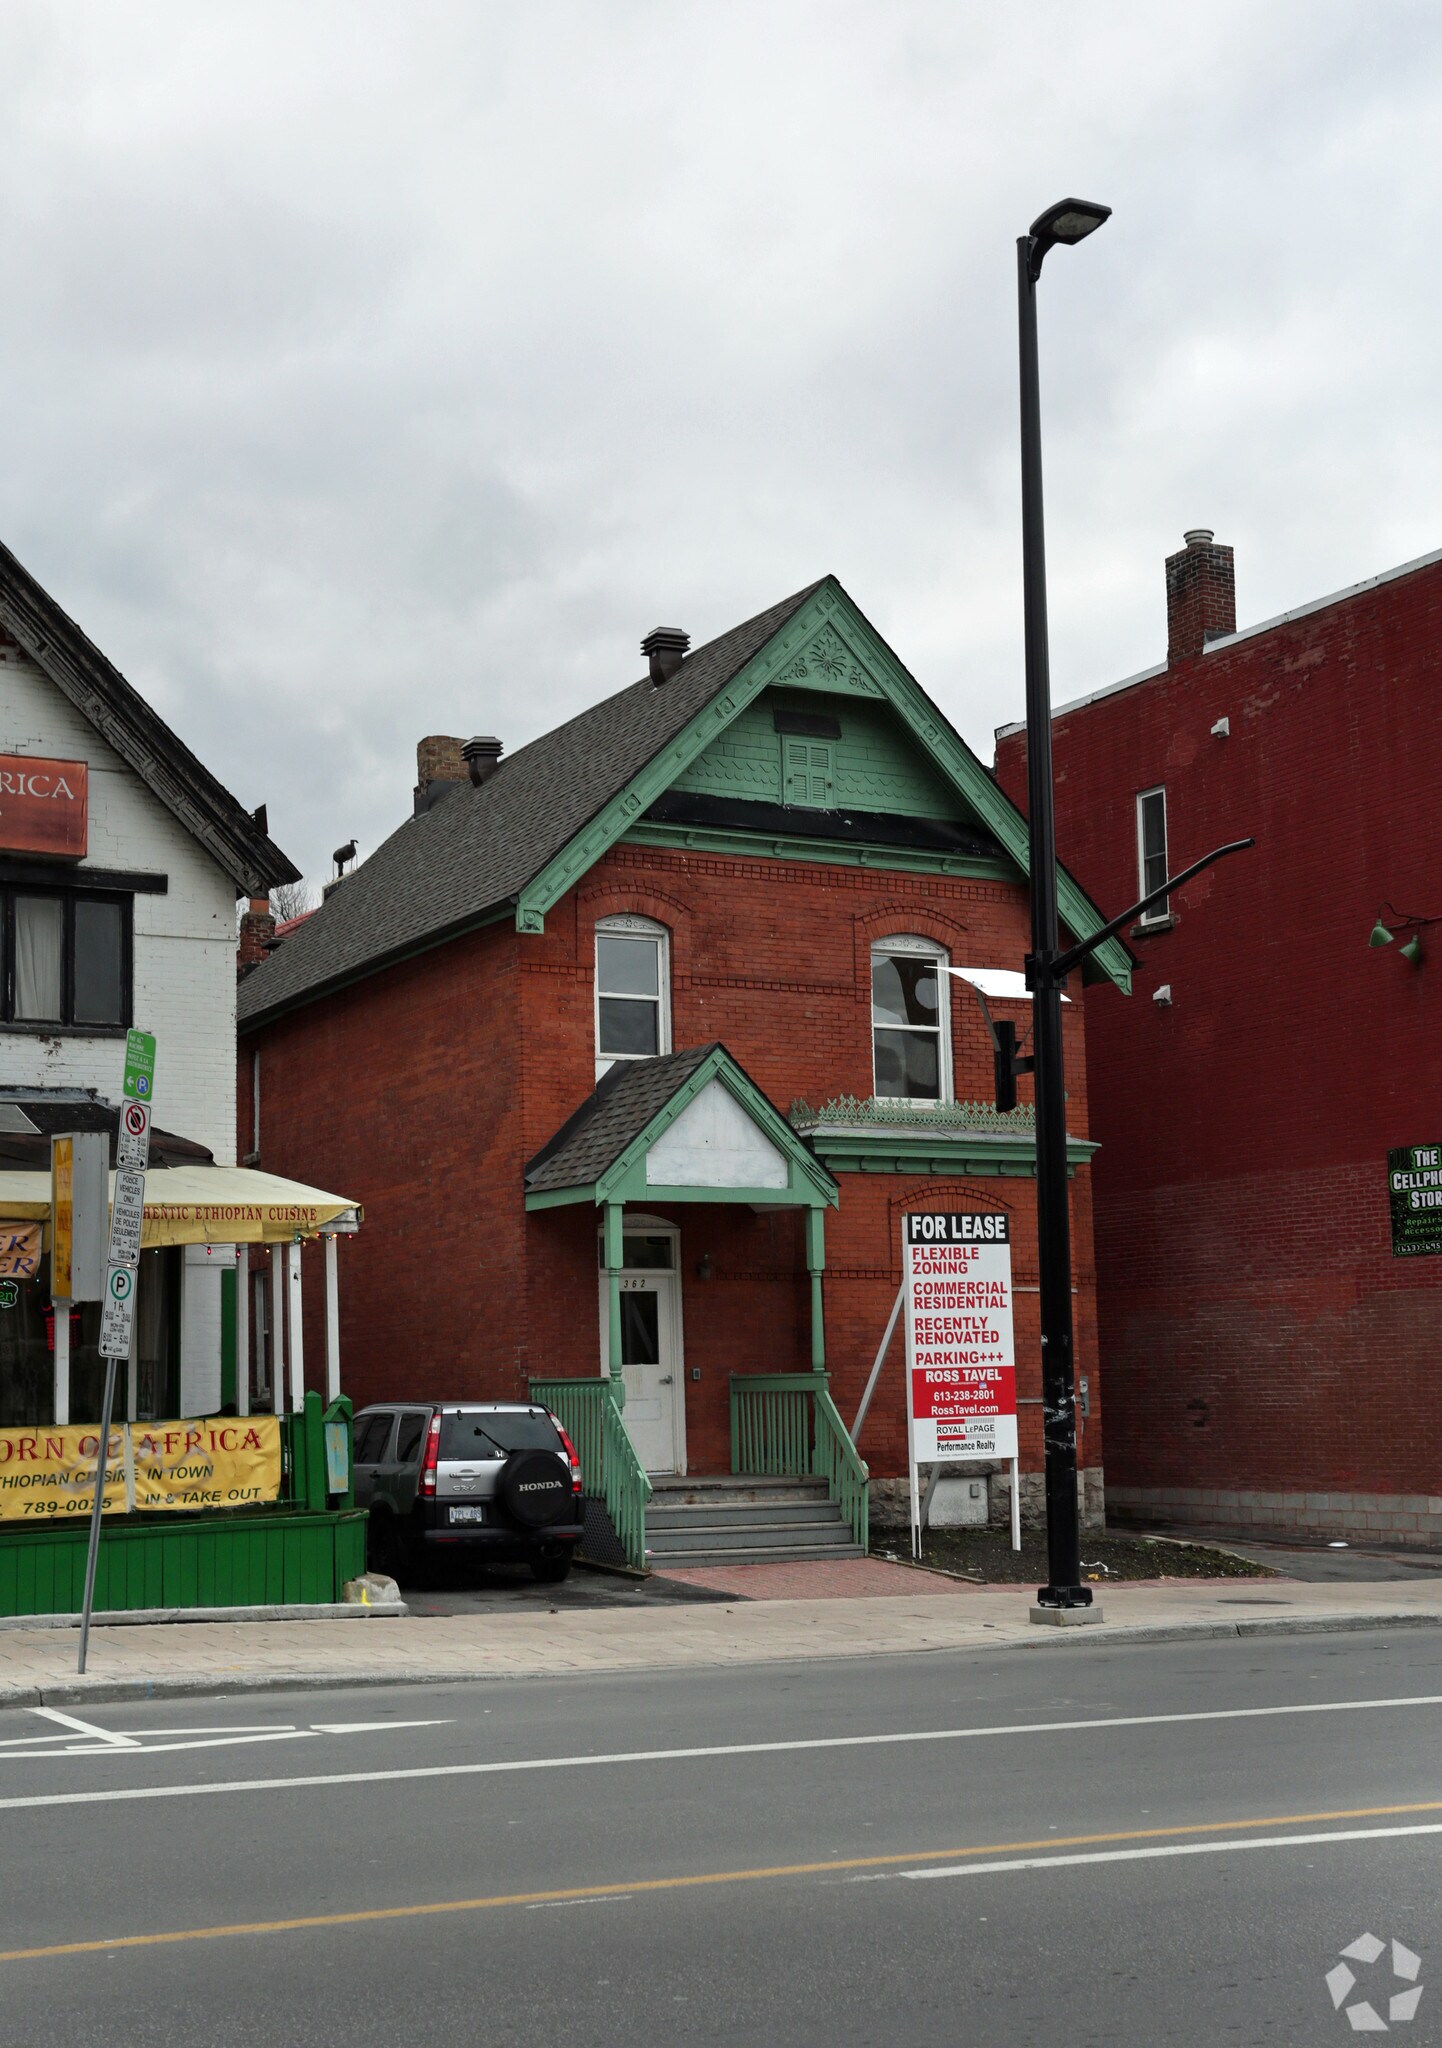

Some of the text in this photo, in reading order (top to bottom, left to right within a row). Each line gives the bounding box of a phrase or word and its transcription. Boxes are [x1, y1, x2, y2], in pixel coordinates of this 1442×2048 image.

[1414, 1149, 1438, 1167] THE
[119, 1184, 141, 1196] VEHICLES
[123, 1195, 135, 1204] ONLY
[143, 1206, 318, 1221] HENTIC ETHIOPIAN CUISINE
[115, 1217, 139, 1229] DE POLICE
[911, 1215, 1006, 1239] FOR LEASE
[113, 1227, 139, 1238] SEULEMENT
[912, 1247, 980, 1260] FLEXIBLE
[912, 1261, 968, 1275] ZONING
[913, 1281, 1008, 1295] COMMERCIAL
[914, 1295, 1008, 1310] RESIDENTIAL
[915, 1316, 989, 1331] RECENTLY
[915, 1330, 1000, 1345] RENOVATED
[915, 1350, 1004, 1366] PARKING+++
[925, 1368, 1003, 1383] ROSS TAVEL
[933, 1389, 995, 1402] 613-238-2801
[931, 1404, 999, 1416] RossTavel.com
[936, 1425, 963, 1434] ROYAL
[138, 1428, 263, 1456] AFRICA
[936, 1440, 996, 1452] Performance Realty
[147, 1468, 163, 1480] IN
[169, 1465, 214, 1480] TOWN
[518, 1480, 564, 1492] HONDA
[145, 1493, 160, 1504] IN
[165, 1492, 175, 1504] &
[182, 1490, 222, 1504] TAKE
[227, 1487, 262, 1501] OUT
